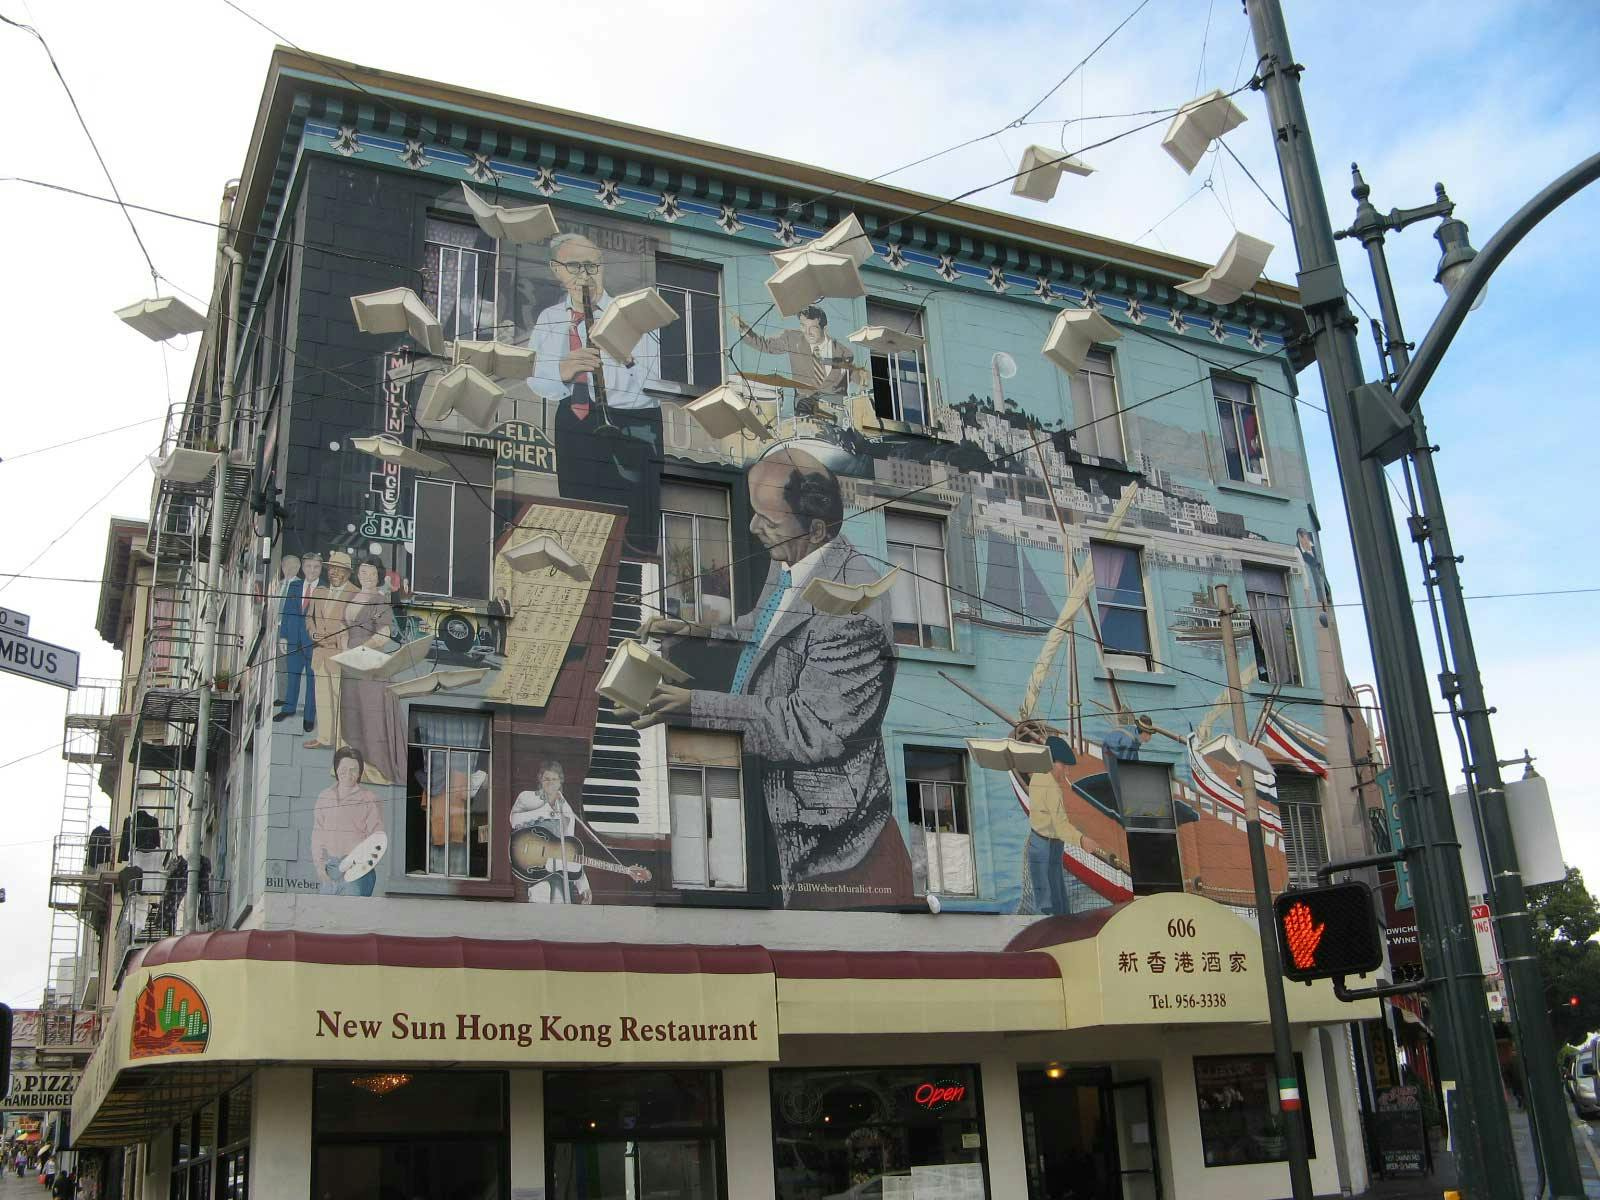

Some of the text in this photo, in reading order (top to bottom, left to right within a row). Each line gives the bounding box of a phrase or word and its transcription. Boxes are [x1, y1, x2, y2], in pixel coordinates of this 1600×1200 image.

[266, 877, 320, 890] Bill Weber
[772, 882, 893, 894] www.BillWeberMuralist.com
[1167, 918, 1196, 938] 606
[1392, 936, 1417, 945] WINE
[1118, 951, 1248, 974] 新香港酒家
[1149, 992, 1227, 1009] Tel. 956-3338
[315, 1010, 758, 1047] New Sun Hong Kong Restaurant
[915, 1084, 965, 1108] Open
